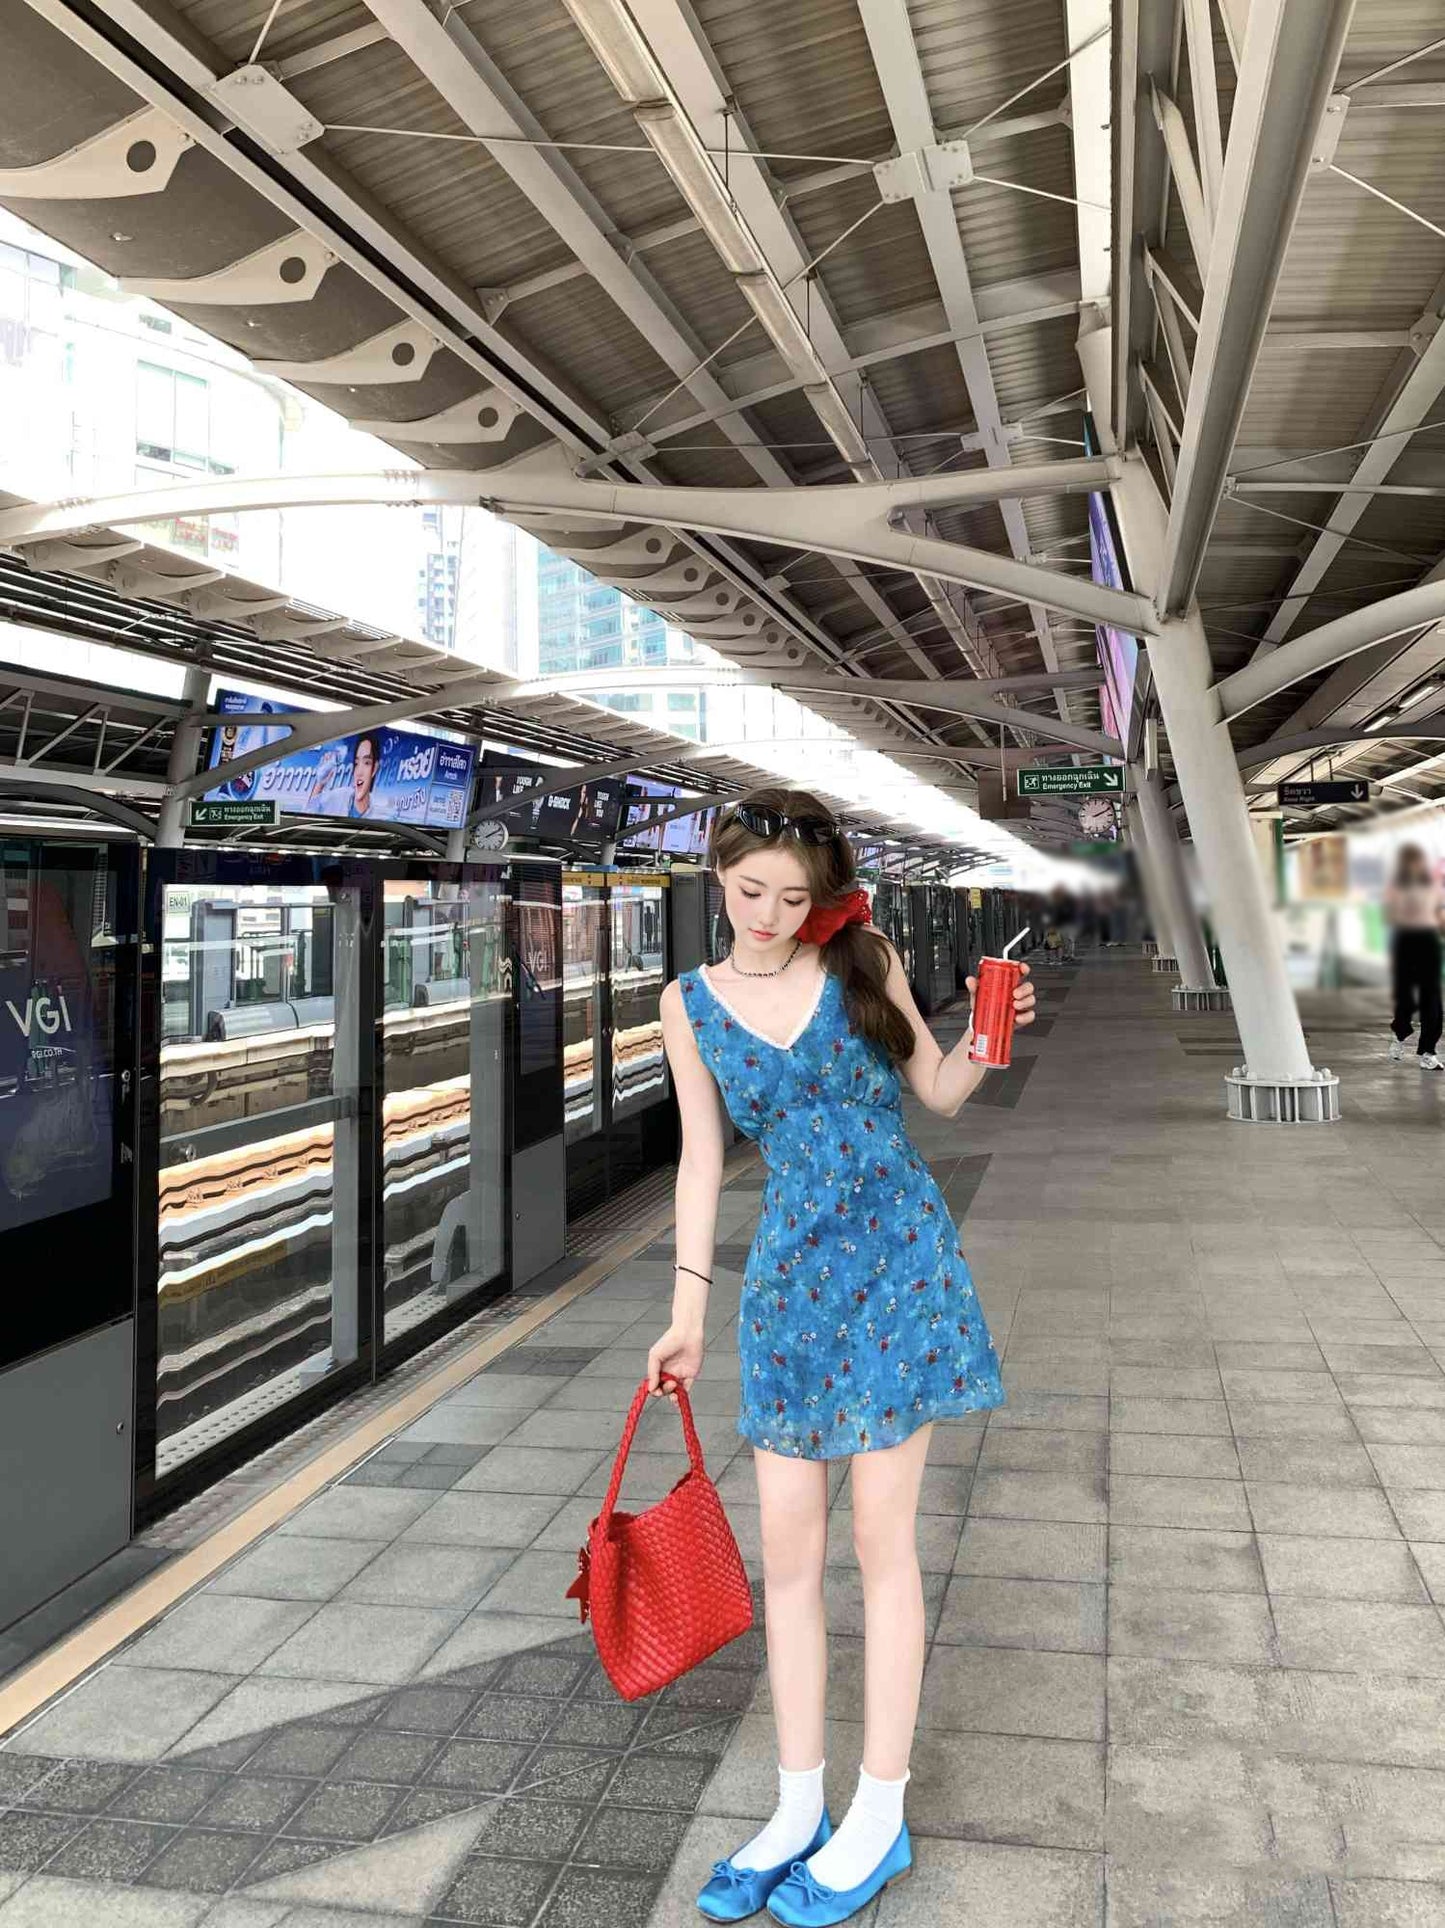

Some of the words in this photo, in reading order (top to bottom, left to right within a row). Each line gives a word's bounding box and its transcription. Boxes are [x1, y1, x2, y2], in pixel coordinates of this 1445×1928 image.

[1041, 770, 1099, 783] ทางออกฉุกเฉิน
[1042, 782, 1077, 791] Emergency
[1078, 781, 1091, 789] Exit
[5, 996, 72, 1037] VGI
